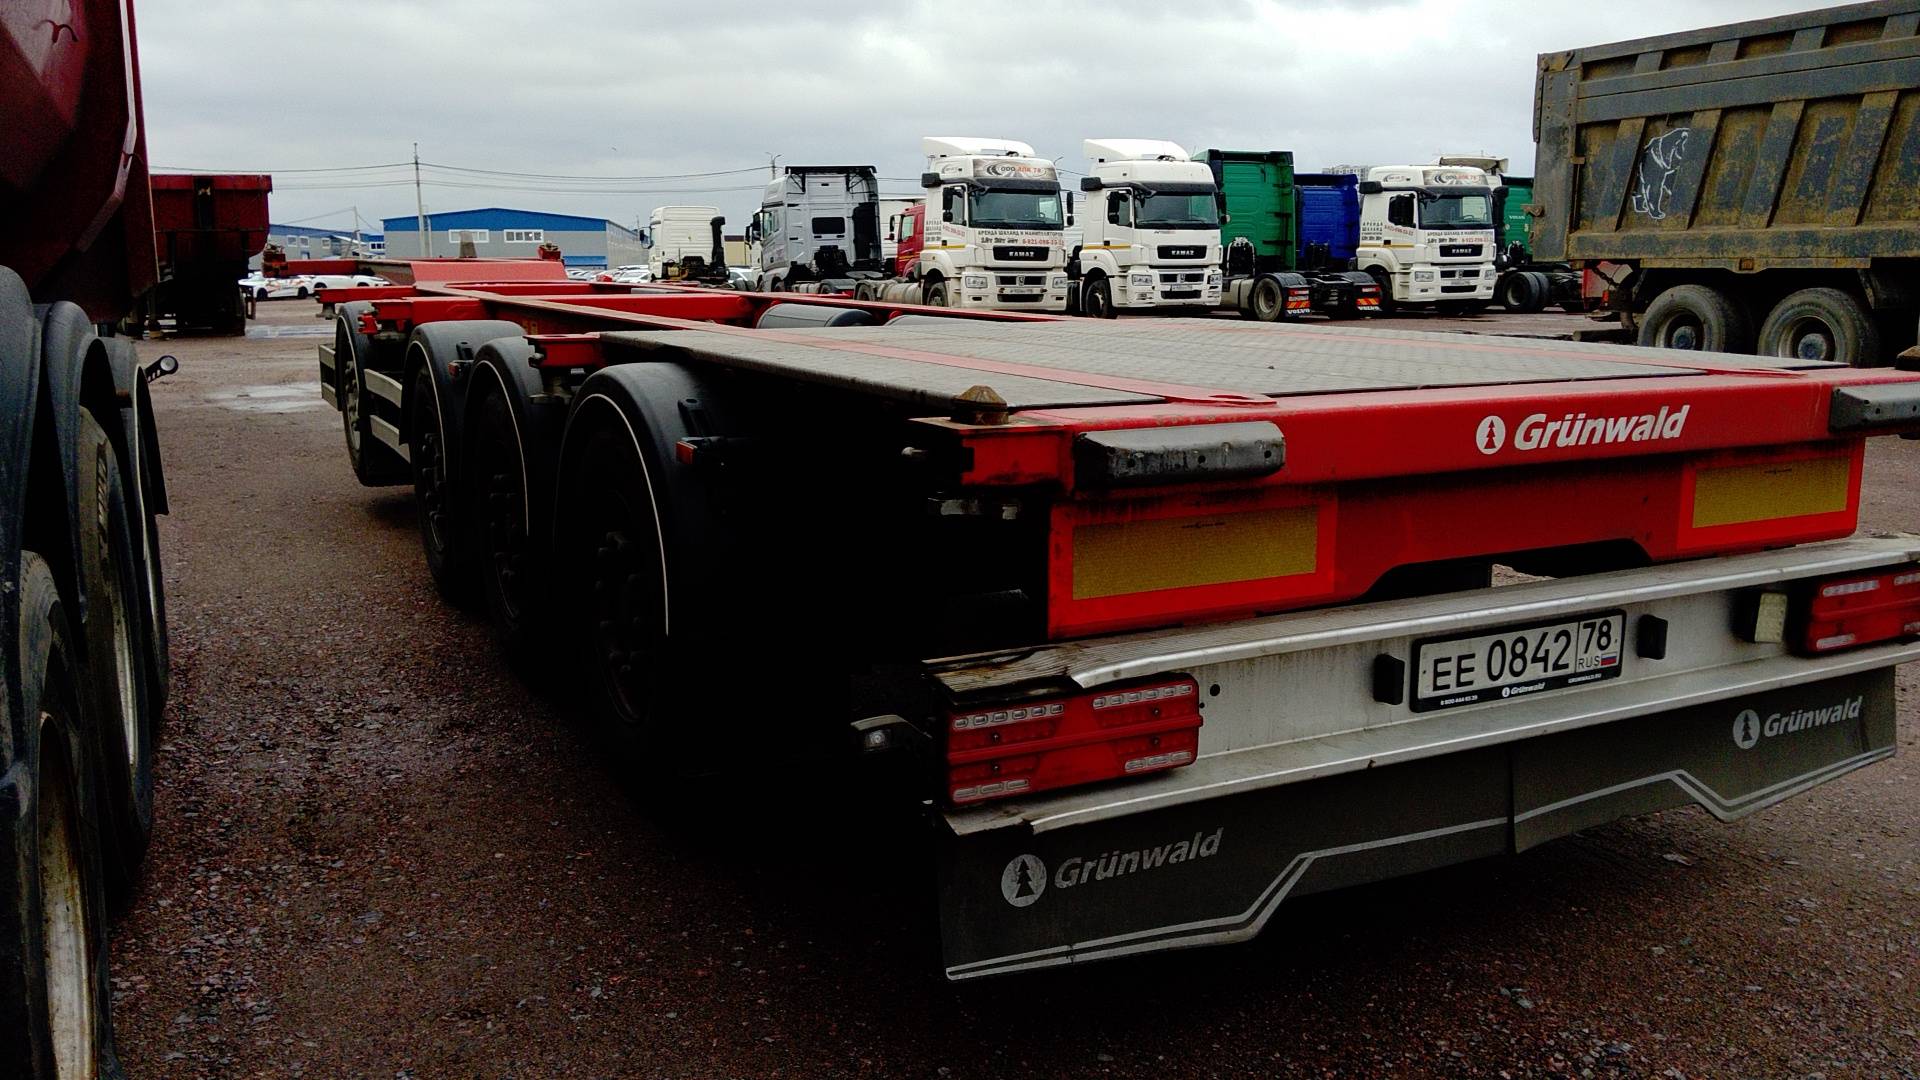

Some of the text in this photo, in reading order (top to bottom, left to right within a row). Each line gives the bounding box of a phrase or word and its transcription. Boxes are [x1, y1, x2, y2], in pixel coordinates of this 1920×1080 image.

[1287, 307, 1311, 315] VOLVO
[1513, 404, 1691, 451] Grünwald
[1486, 629, 1572, 682] 0842
[1582, 619, 1612, 654] 78
[1577, 655, 1600, 669] RUS
[1510, 681, 1546, 695] Grünwald
[1764, 695, 1863, 738] Grünwald
[1054, 827, 1224, 889] Grünwald
